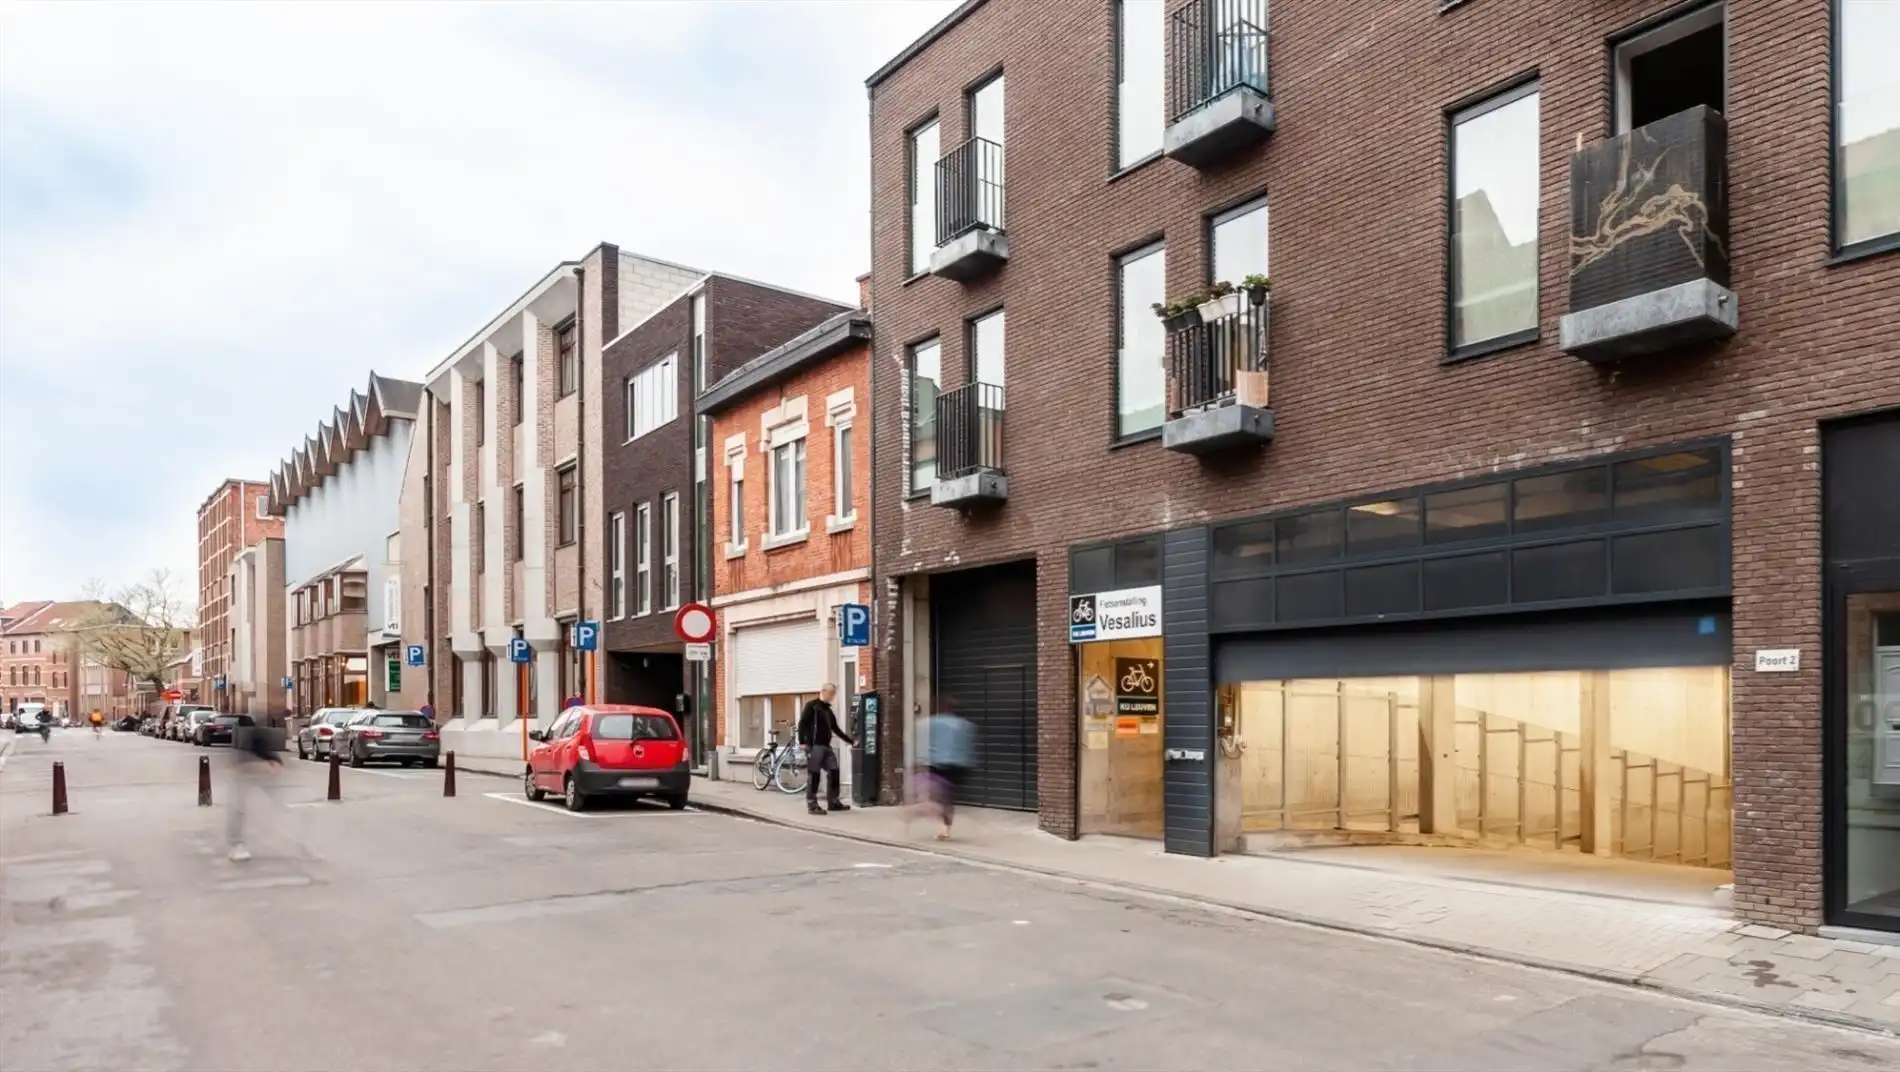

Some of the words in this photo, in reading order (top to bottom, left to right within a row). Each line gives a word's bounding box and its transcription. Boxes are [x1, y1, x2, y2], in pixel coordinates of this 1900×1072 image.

[847, 607, 866, 637] P
[1099, 609, 1157, 631] Vesalius
[579, 626, 594, 646] P
[409, 647, 421, 661] P
[513, 640, 527, 657] P
